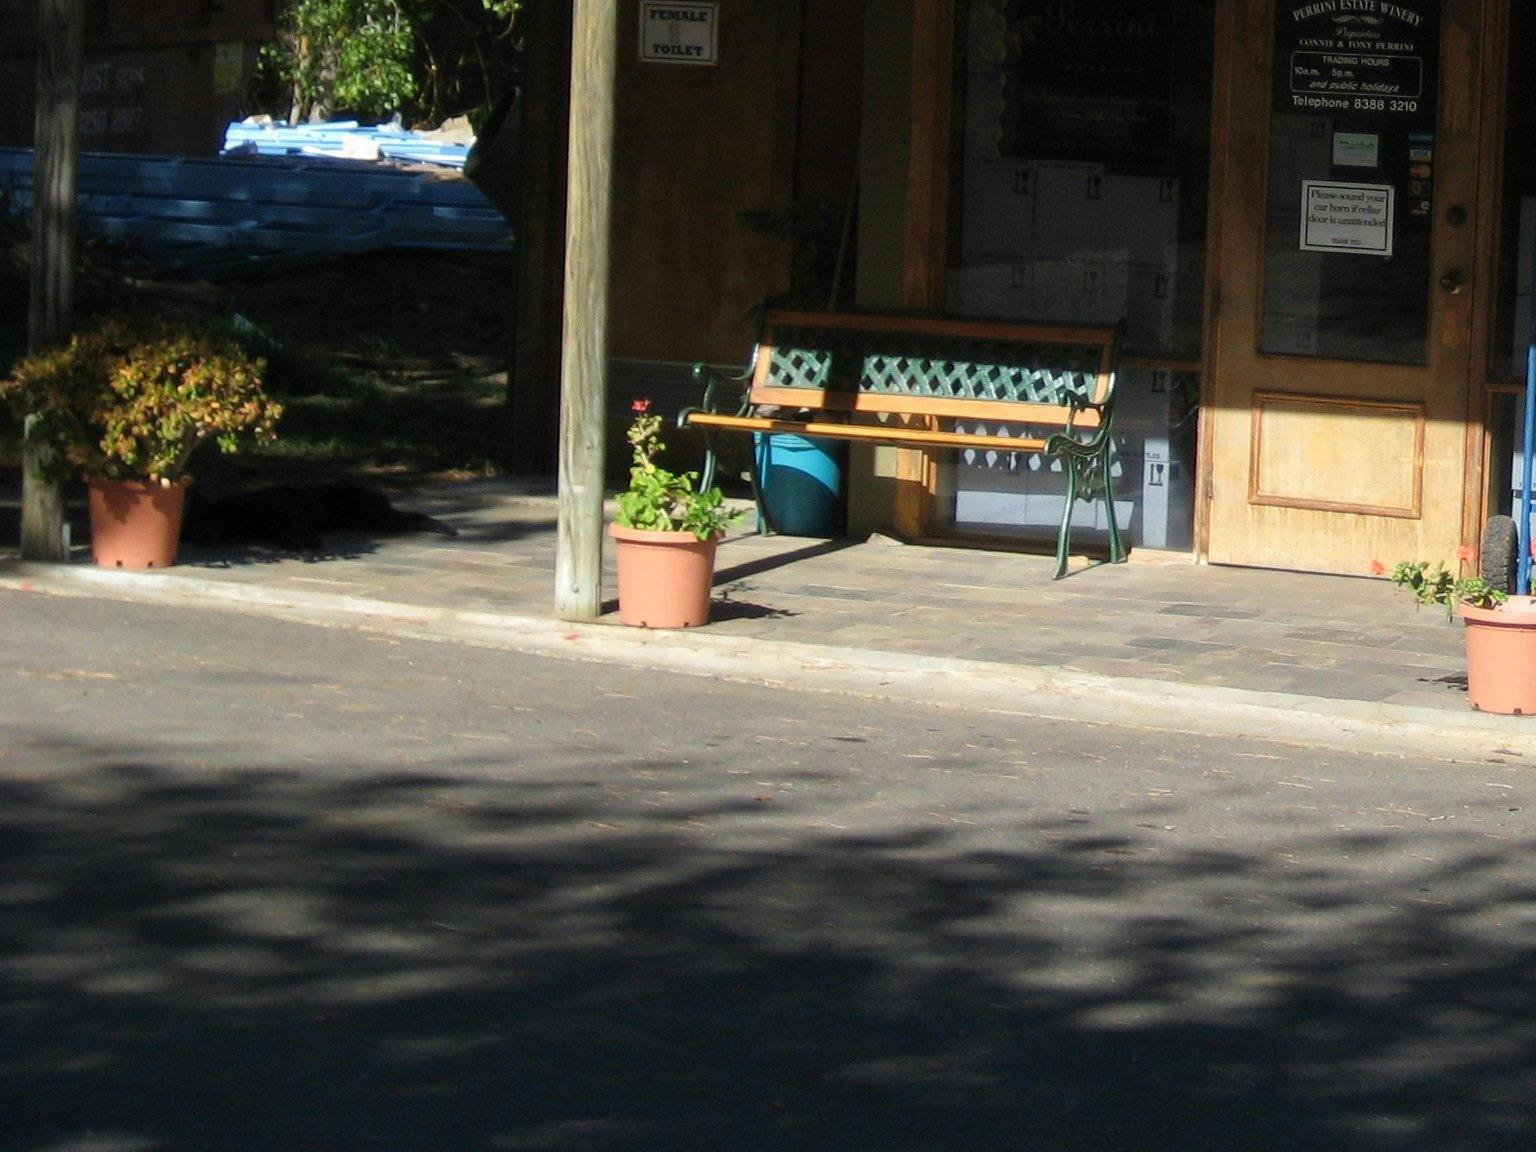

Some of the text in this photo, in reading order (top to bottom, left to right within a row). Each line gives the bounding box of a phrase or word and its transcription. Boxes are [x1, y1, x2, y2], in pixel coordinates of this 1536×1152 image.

[649, 9, 707, 22] FEMALE
[1293, 0, 1336, 22] PERRINI
[1380, 2, 1423, 27] WINERY
[651, 44, 704, 56] TOILET
[1299, 38, 1334, 48] CONNIE
[1337, 40, 1345, 49] &
[1349, 41, 1373, 50] TONY
[1322, 55, 1390, 68] TRADING HOURS
[1308, 80, 1400, 94] and public holidays
[1292, 94, 1417, 113] Telephone 8388 3210
[1311, 189, 1338, 200] Please
[1366, 194, 1386, 203] your
[1313, 204, 1328, 212] car
[1330, 203, 1350, 213] horn
[1309, 214, 1328, 224] door
